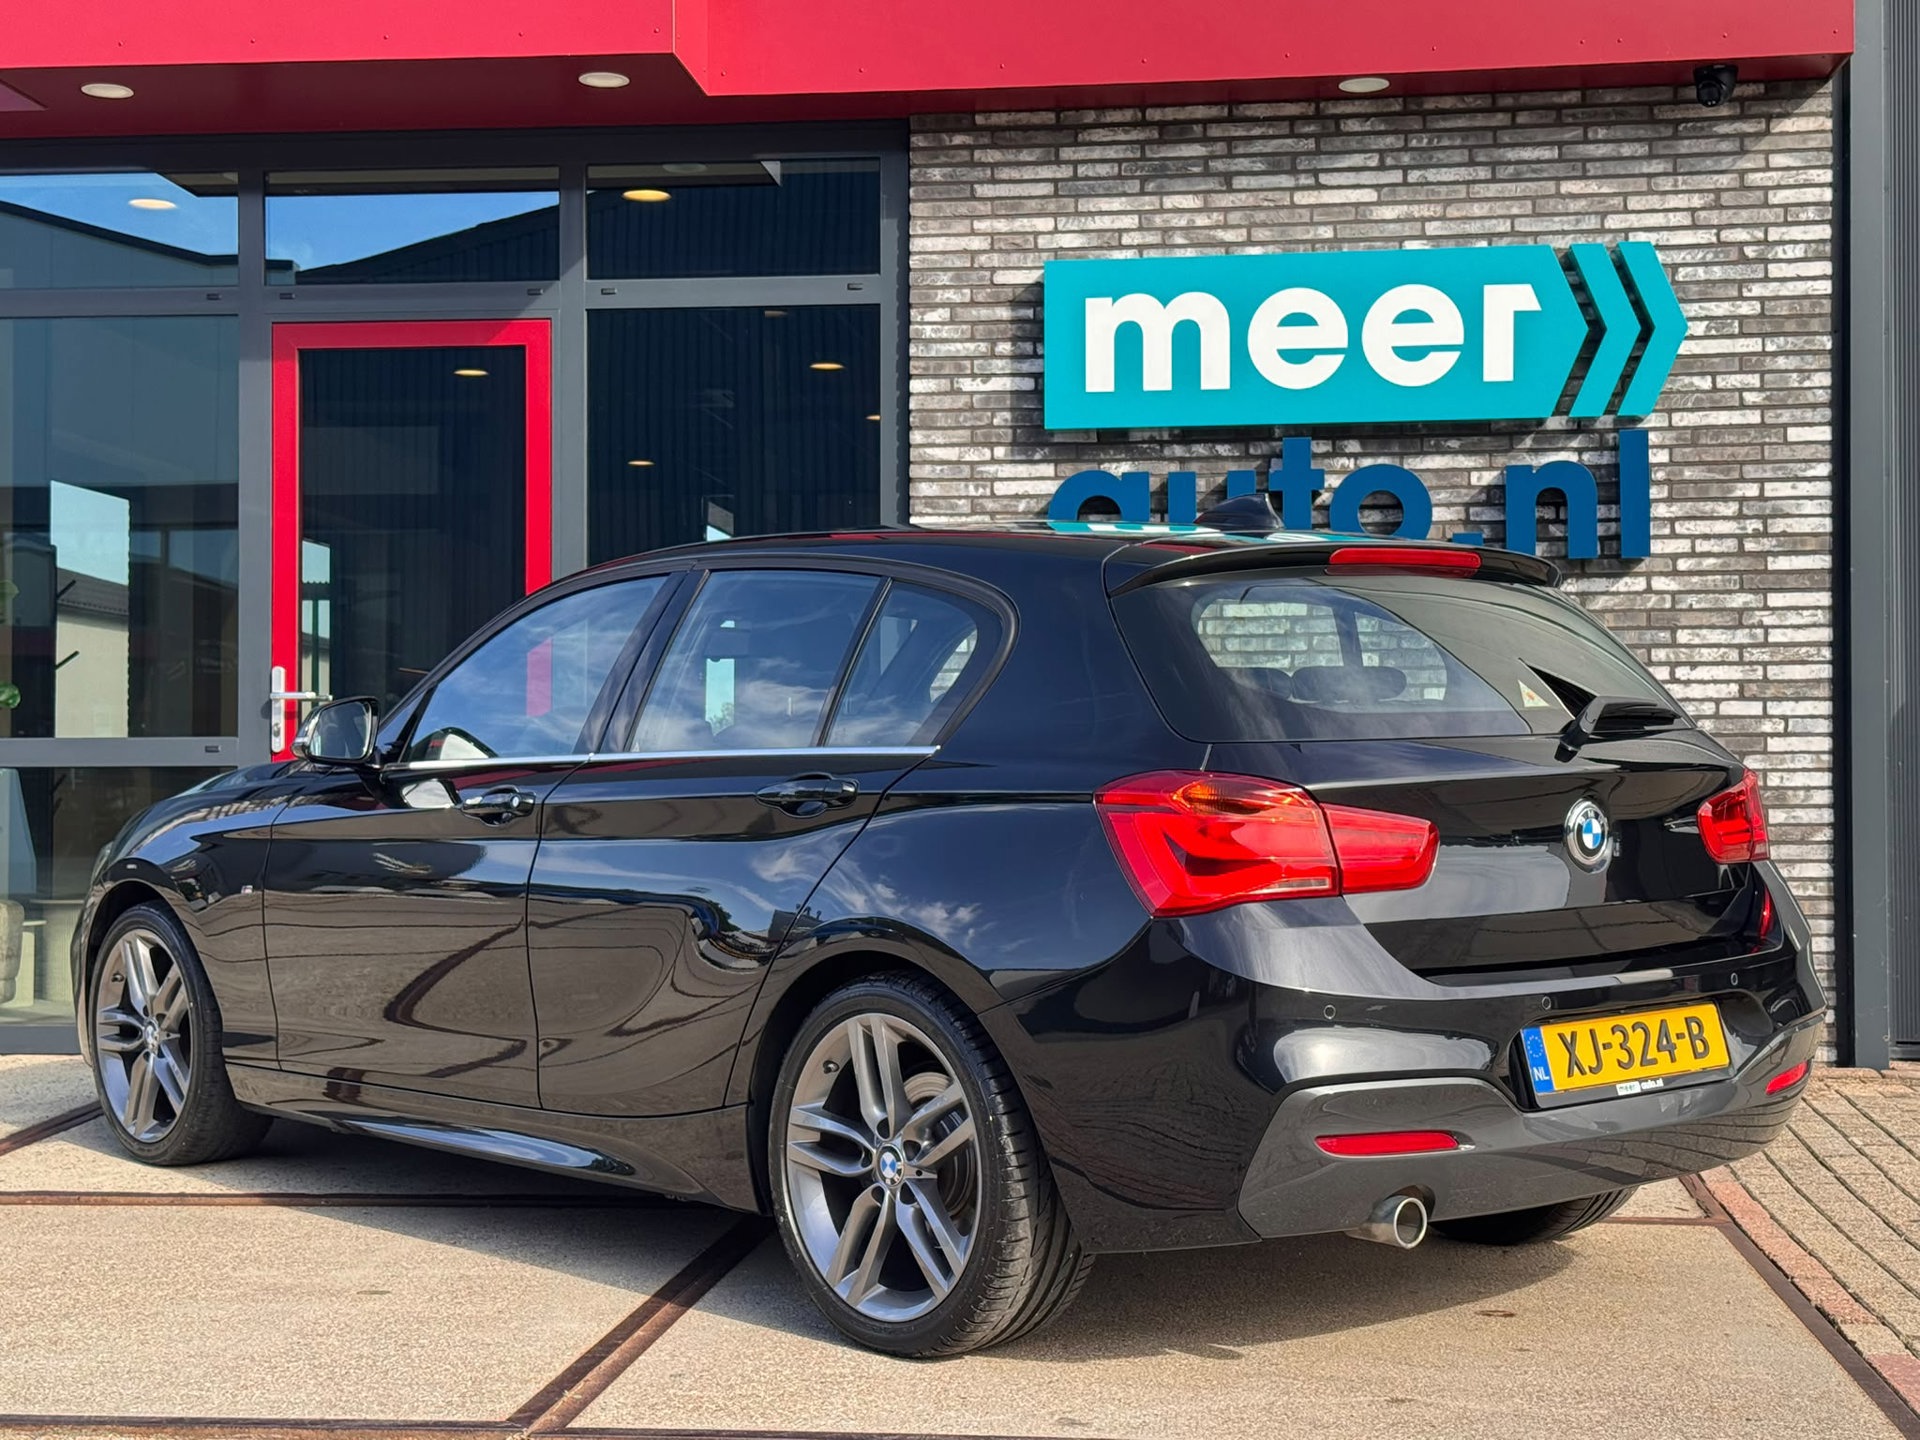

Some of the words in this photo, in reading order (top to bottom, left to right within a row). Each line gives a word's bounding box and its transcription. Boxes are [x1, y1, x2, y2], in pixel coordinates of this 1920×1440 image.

[1085, 283, 1541, 392] meer
[1533, 1066, 1550, 1081] NL
[1558, 1016, 1710, 1078] XJ-324-B
